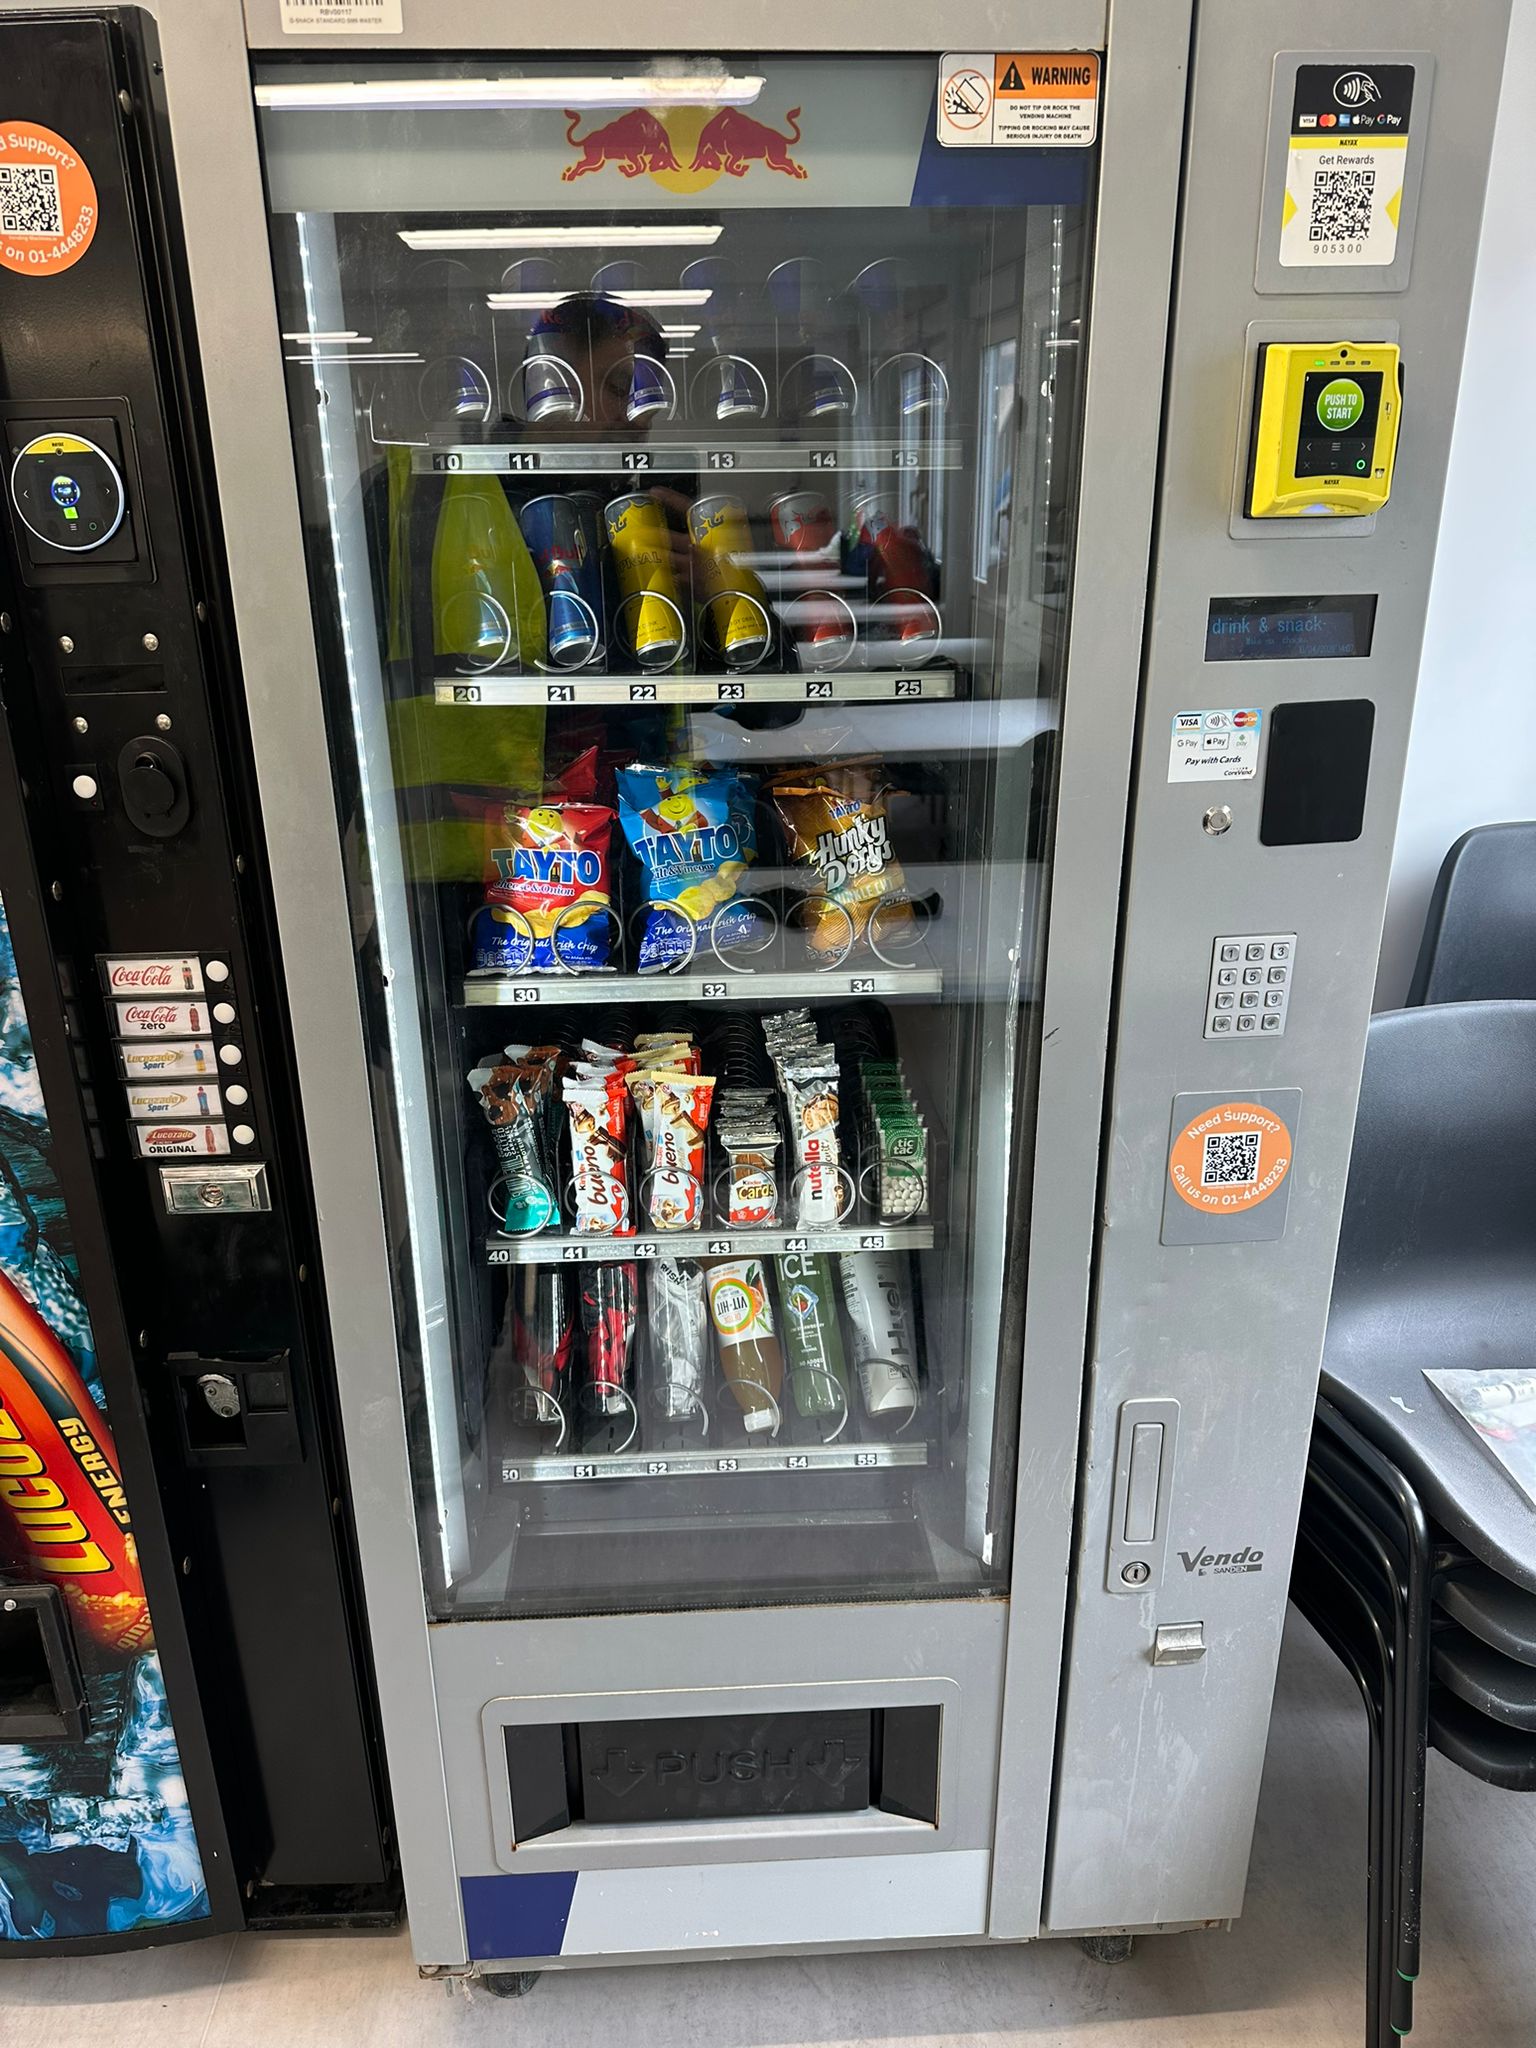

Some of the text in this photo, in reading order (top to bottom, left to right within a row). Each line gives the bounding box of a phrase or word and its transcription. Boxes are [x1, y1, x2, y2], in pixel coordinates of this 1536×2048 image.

[1031, 66, 1091, 86] WARNING
[1360, 114, 1375, 127] Pay
[1386, 115, 1402, 126] Pay
[7, 132, 78, 171] Support?
[1319, 155, 1375, 165] Get Rewards
[5, 205, 94, 264] on 01-4448233
[1324, 393, 1358, 406] PUSH TO
[1326, 407, 1353, 420] START
[436, 455, 460, 470] 10
[512, 454, 535, 469] 11
[624, 454, 649, 469] 12
[710, 453, 735, 468] 13
[812, 452, 837, 468] 14
[895, 451, 919, 466] 15
[1212, 615, 1322, 634] drink & snack
[455, 687, 480, 701] 20
[550, 687, 574, 700] 21
[632, 686, 656, 699] 22
[720, 685, 744, 699] 23
[809, 684, 832, 697] 24
[897, 682, 921, 695] 25
[1180, 718, 1199, 726] VISA
[1185, 740, 1198, 748] Pay
[1212, 737, 1226, 746] Pay
[1184, 757, 1200, 766] Pay
[1219, 755, 1242, 763] Cards
[633, 823, 739, 868] TAYTO
[813, 813, 888, 867] Hunky
[490, 848, 602, 886] TAYTO
[676, 863, 716, 875] Vinegar
[824, 839, 893, 893] Dorys
[540, 885, 575, 896] Onion
[655, 926, 674, 936] The
[714, 915, 736, 928] rish
[491, 937, 509, 945] The
[510, 936, 550, 950] Orignal
[553, 939, 576, 950] rish
[111, 964, 175, 987] Coca-Cola
[704, 984, 726, 997] 32
[852, 979, 874, 993] 34
[515, 989, 537, 1002] 30
[125, 1005, 180, 1024] Coca-Cola
[140, 1020, 166, 1031] zero
[127, 1053, 174, 1063] Lucozade
[143, 1062, 165, 1070] Sport
[131, 1095, 178, 1105] Lucozade
[147, 1104, 170, 1112] Sport
[1187, 1110, 1281, 1140] Need Support?
[152, 1130, 194, 1139] Lucozade
[897, 1137, 914, 1147] tic
[148, 1145, 197, 1154] ORIGINAL
[893, 1145, 914, 1155] tac
[661, 1132, 680, 1185] bueno
[583, 1145, 609, 1206] bueno
[804, 1138, 824, 1202] nutella
[1173, 1157, 1288, 1206] Call us on 01-4448233
[737, 1184, 775, 1200] Cards
[710, 1242, 731, 1253] 43
[786, 1240, 807, 1251] 44
[863, 1237, 884, 1248] 45
[488, 1250, 509, 1262] 40
[564, 1248, 584, 1259] 41
[635, 1245, 656, 1256] 42
[878, 1281, 910, 1356] Huel
[718, 1460, 737, 1471] 53
[788, 1457, 808, 1468] 54
[857, 1454, 876, 1466] 55
[57, 1416, 132, 1525] ENERGY
[502, 1469, 519, 1480] 50
[575, 1466, 594, 1478] 51
[648, 1463, 668, 1474] 52
[1177, 1546, 1264, 1573] Vendo
[1213, 1565, 1248, 1575] SANDEN
[654, 1745, 799, 1789] PUSH
